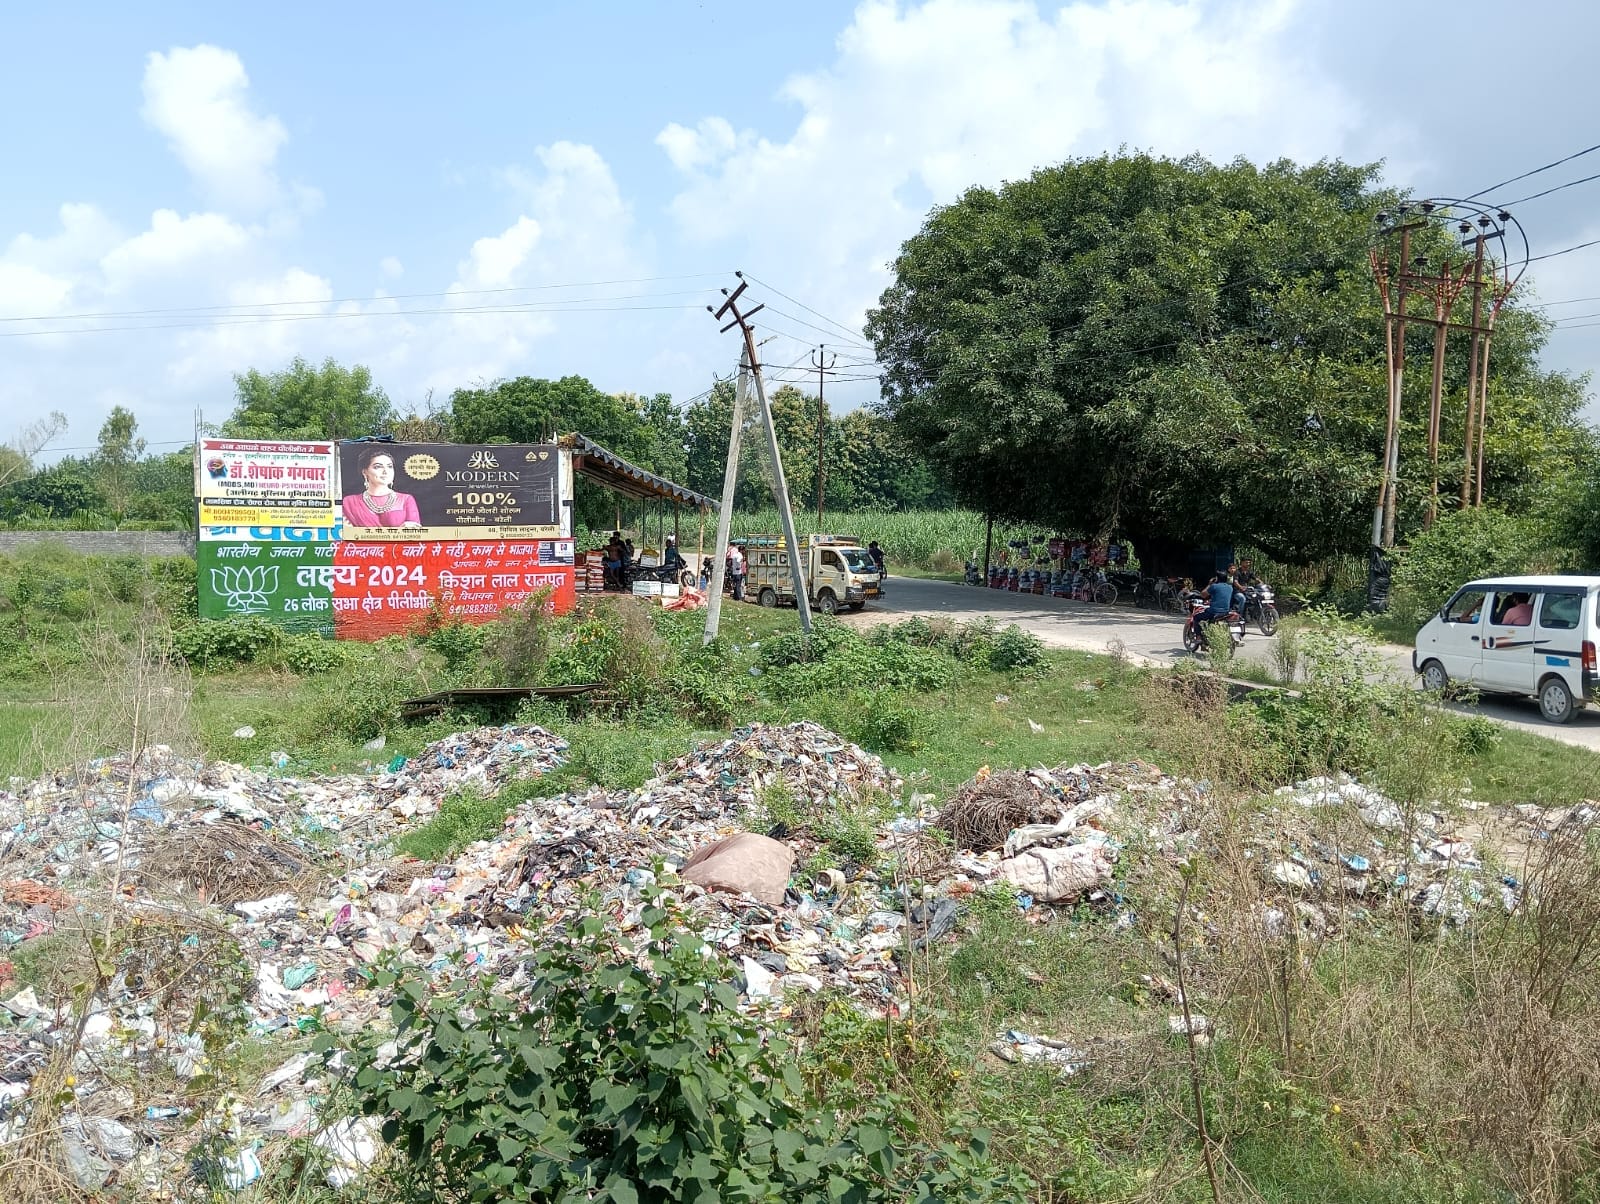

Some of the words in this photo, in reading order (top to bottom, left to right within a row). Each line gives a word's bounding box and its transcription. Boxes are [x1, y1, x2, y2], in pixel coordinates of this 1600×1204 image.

[288, 462, 326, 480] गंगवार
[446, 471, 520, 482] MODERN
[452, 492, 516, 505] 100%
[216, 543, 262, 558] भारतीय
[270, 546, 306, 558] जनता
[314, 541, 340, 558] पार्टी
[344, 542, 386, 558] जिन्दाबाद
[432, 542, 443, 556] से
[472, 545, 494, 556] काम
[496, 541, 506, 556] से
[438, 570, 487, 590] किशन
[492, 574, 520, 588] लाल
[525, 573, 567, 589] राजपूत
[284, 598, 298, 611] 26
[302, 592, 329, 611] लोक
[332, 598, 360, 612] सभा
[362, 592, 383, 614] क्षेत्र
[460, 590, 495, 601] विधायक
